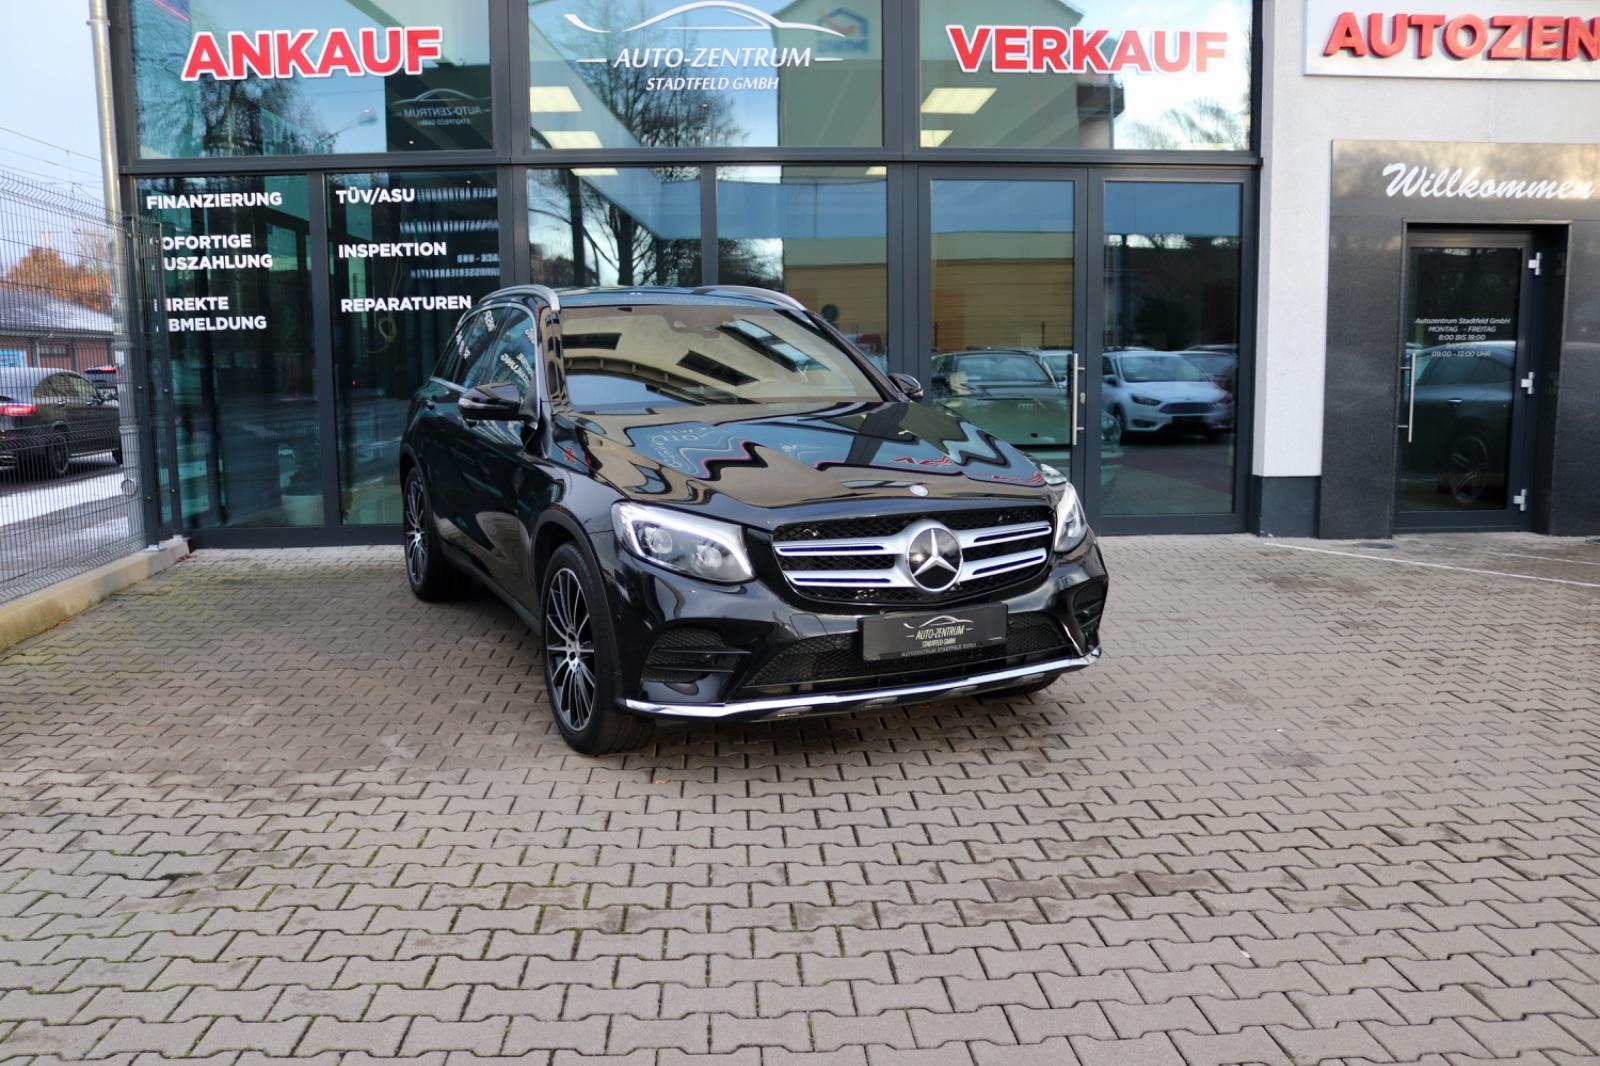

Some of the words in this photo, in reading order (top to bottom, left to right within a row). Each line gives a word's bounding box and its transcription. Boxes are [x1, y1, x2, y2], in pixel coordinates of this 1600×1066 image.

[1323, 12, 1600, 61] AUTOZEN
[181, 27, 442, 81] ANKAUF
[614, 47, 811, 69] AUTO-ZENTRUM
[945, 25, 1228, 74] VERKAUF
[646, 77, 730, 91] STADTFELD
[732, 76, 780, 90] GMBH
[1382, 162, 1596, 199] Willkommen
[146, 192, 282, 210] FINANZIERUNG
[335, 187, 415, 205] TÜV/ASU
[150, 234, 252, 250] OFORTIGE
[338, 242, 447, 258] INSPEKTION
[152, 254, 273, 271] USZAHLUNG
[154, 296, 229, 312] IREKTE
[341, 296, 472, 313] REPARATUREN
[156, 316, 267, 332] BMELDUNG
[915, 625, 965, 641] AUTO-ZENTRUM
